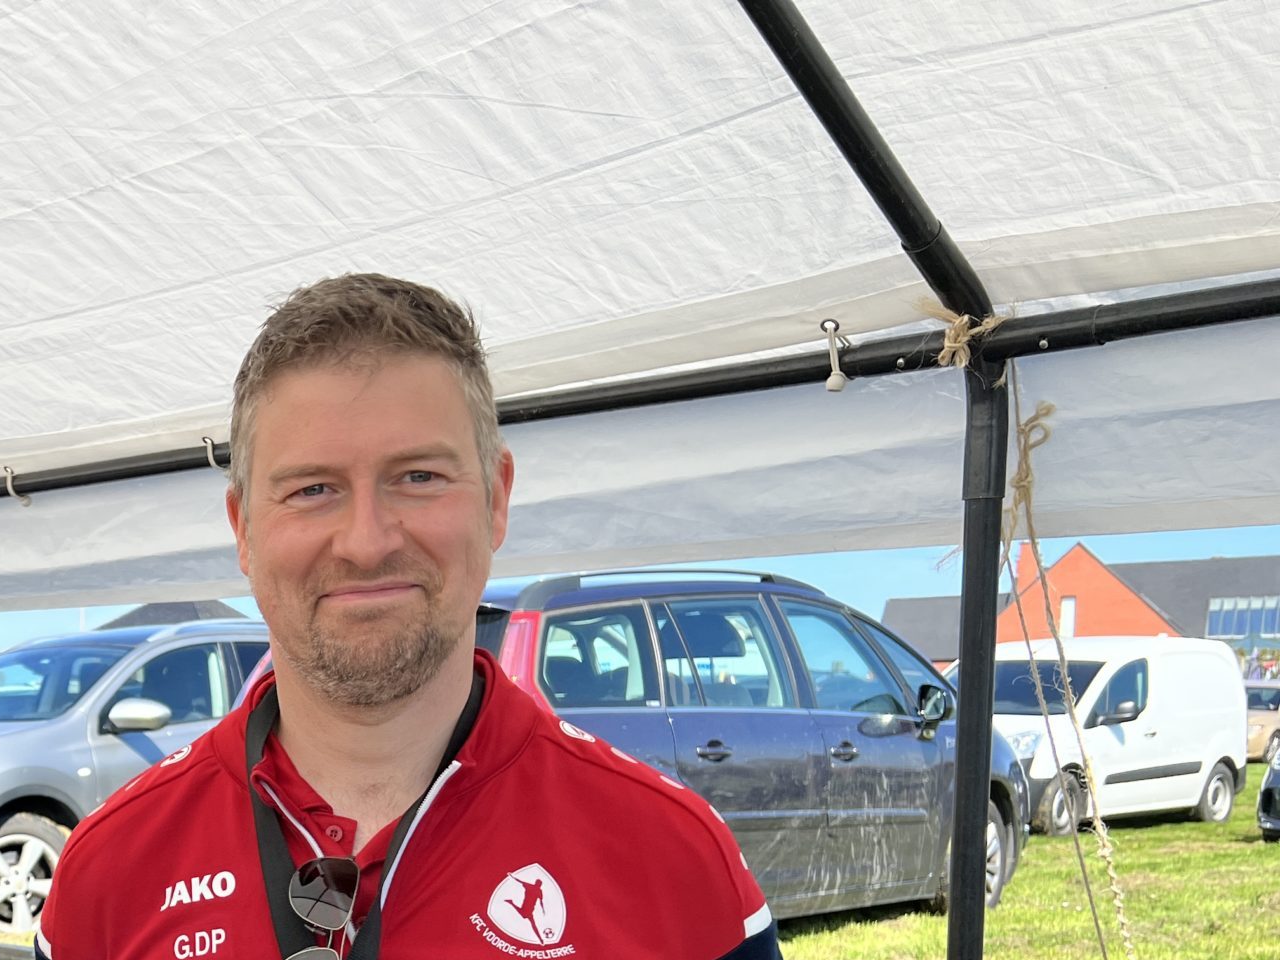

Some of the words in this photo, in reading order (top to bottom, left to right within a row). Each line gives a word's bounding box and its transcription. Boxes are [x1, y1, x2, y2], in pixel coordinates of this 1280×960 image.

[160, 871, 236, 912] JAKO
[469, 912, 487, 932] KFC
[173, 928, 226, 960] G.DP
